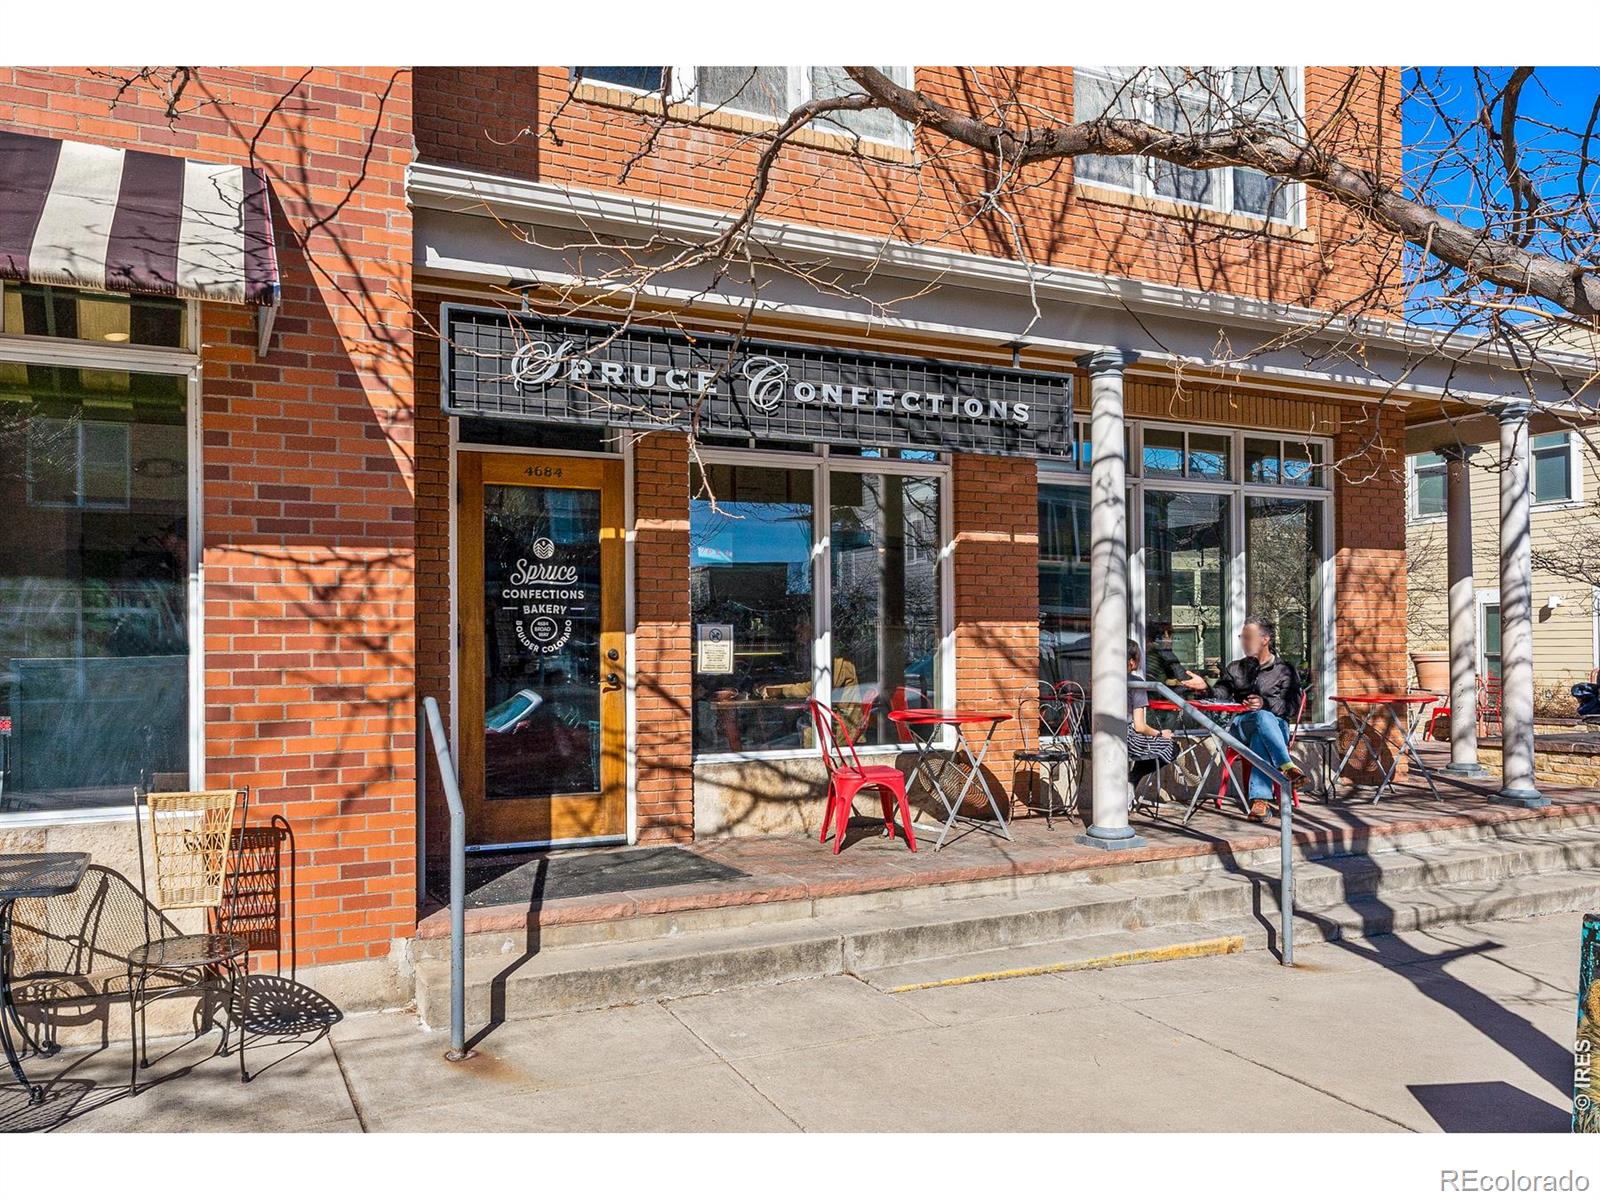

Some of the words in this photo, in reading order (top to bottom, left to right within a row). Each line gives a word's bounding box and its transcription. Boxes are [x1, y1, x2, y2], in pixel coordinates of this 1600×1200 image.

[743, 356, 1030, 423] CONFECTIONS
[524, 465, 563, 478] 4684
[510, 558, 578, 586] Spruce
[502, 589, 585, 599] CONFECTIONS
[523, 604, 567, 614] BAKERY
[515, 620, 540, 653] BOULDER
[541, 619, 572, 653] COLORADO
